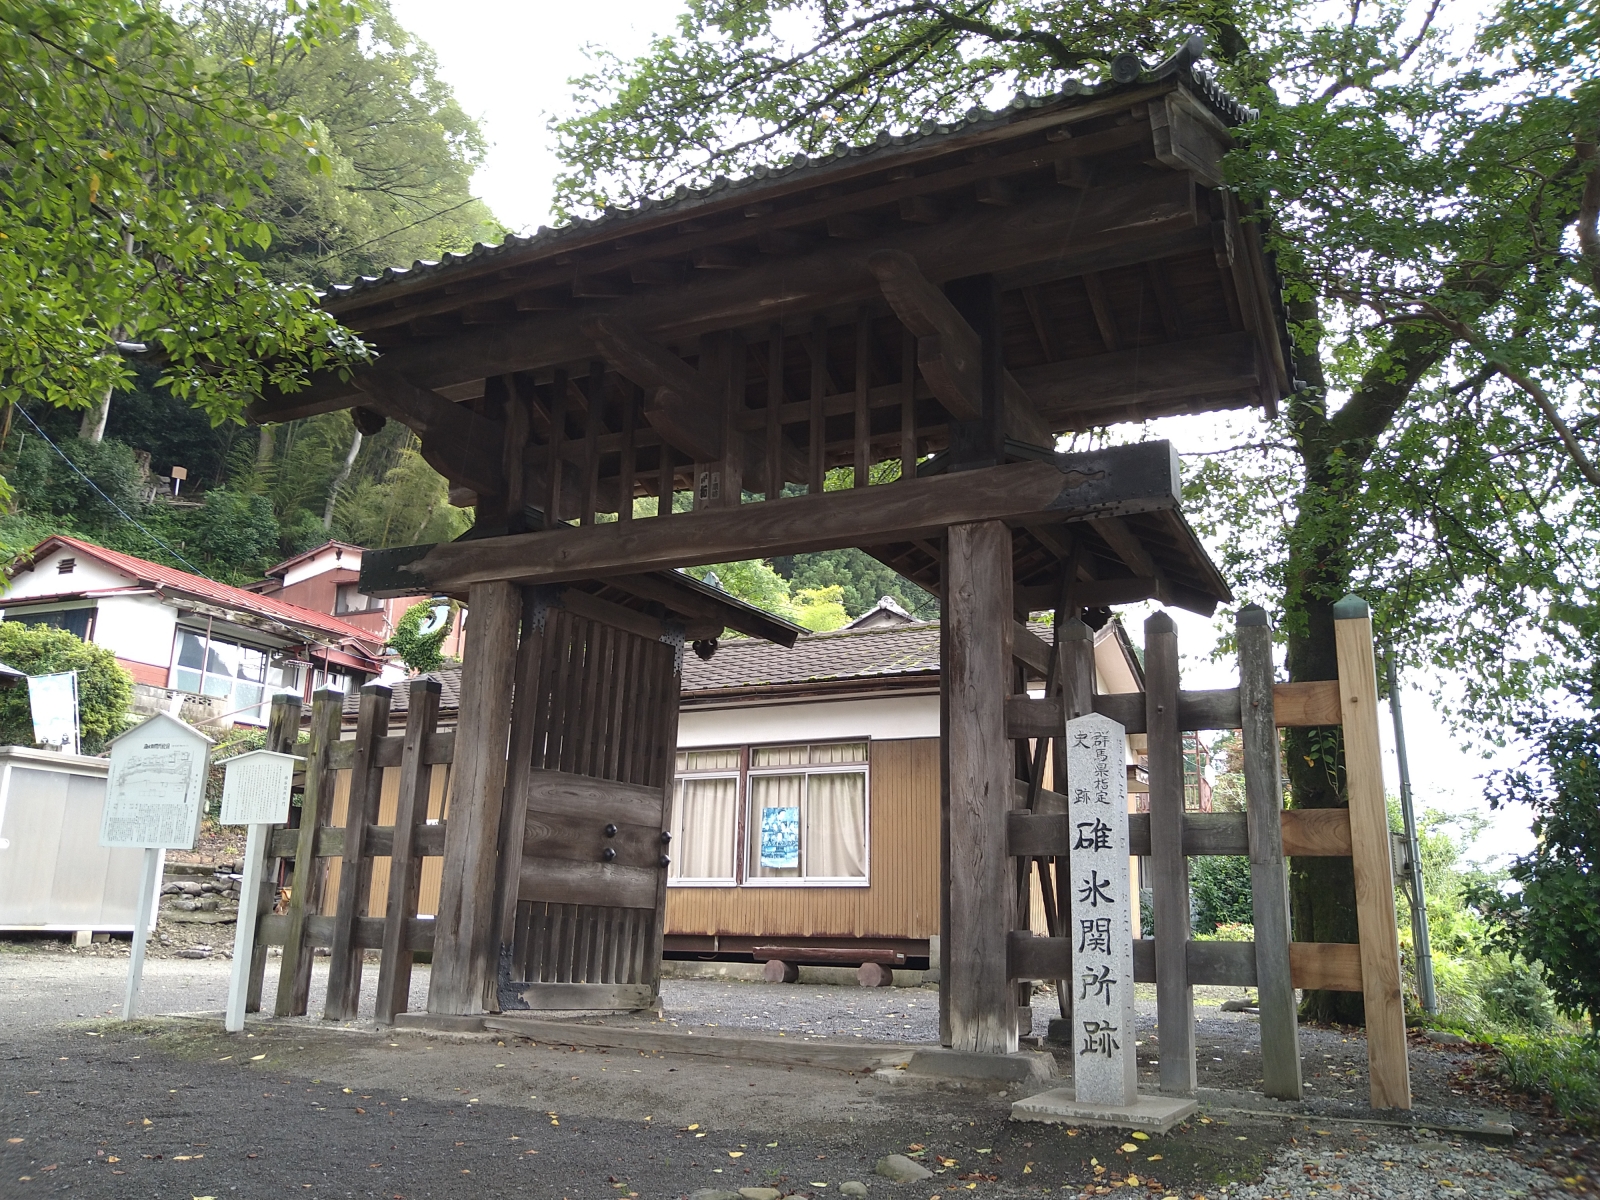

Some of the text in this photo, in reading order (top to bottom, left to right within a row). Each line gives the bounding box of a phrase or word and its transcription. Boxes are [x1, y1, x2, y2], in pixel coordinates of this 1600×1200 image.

[1091, 730, 1110, 805] 群馬県指定
[1073, 818, 1120, 1058] 碓氷関所跡
